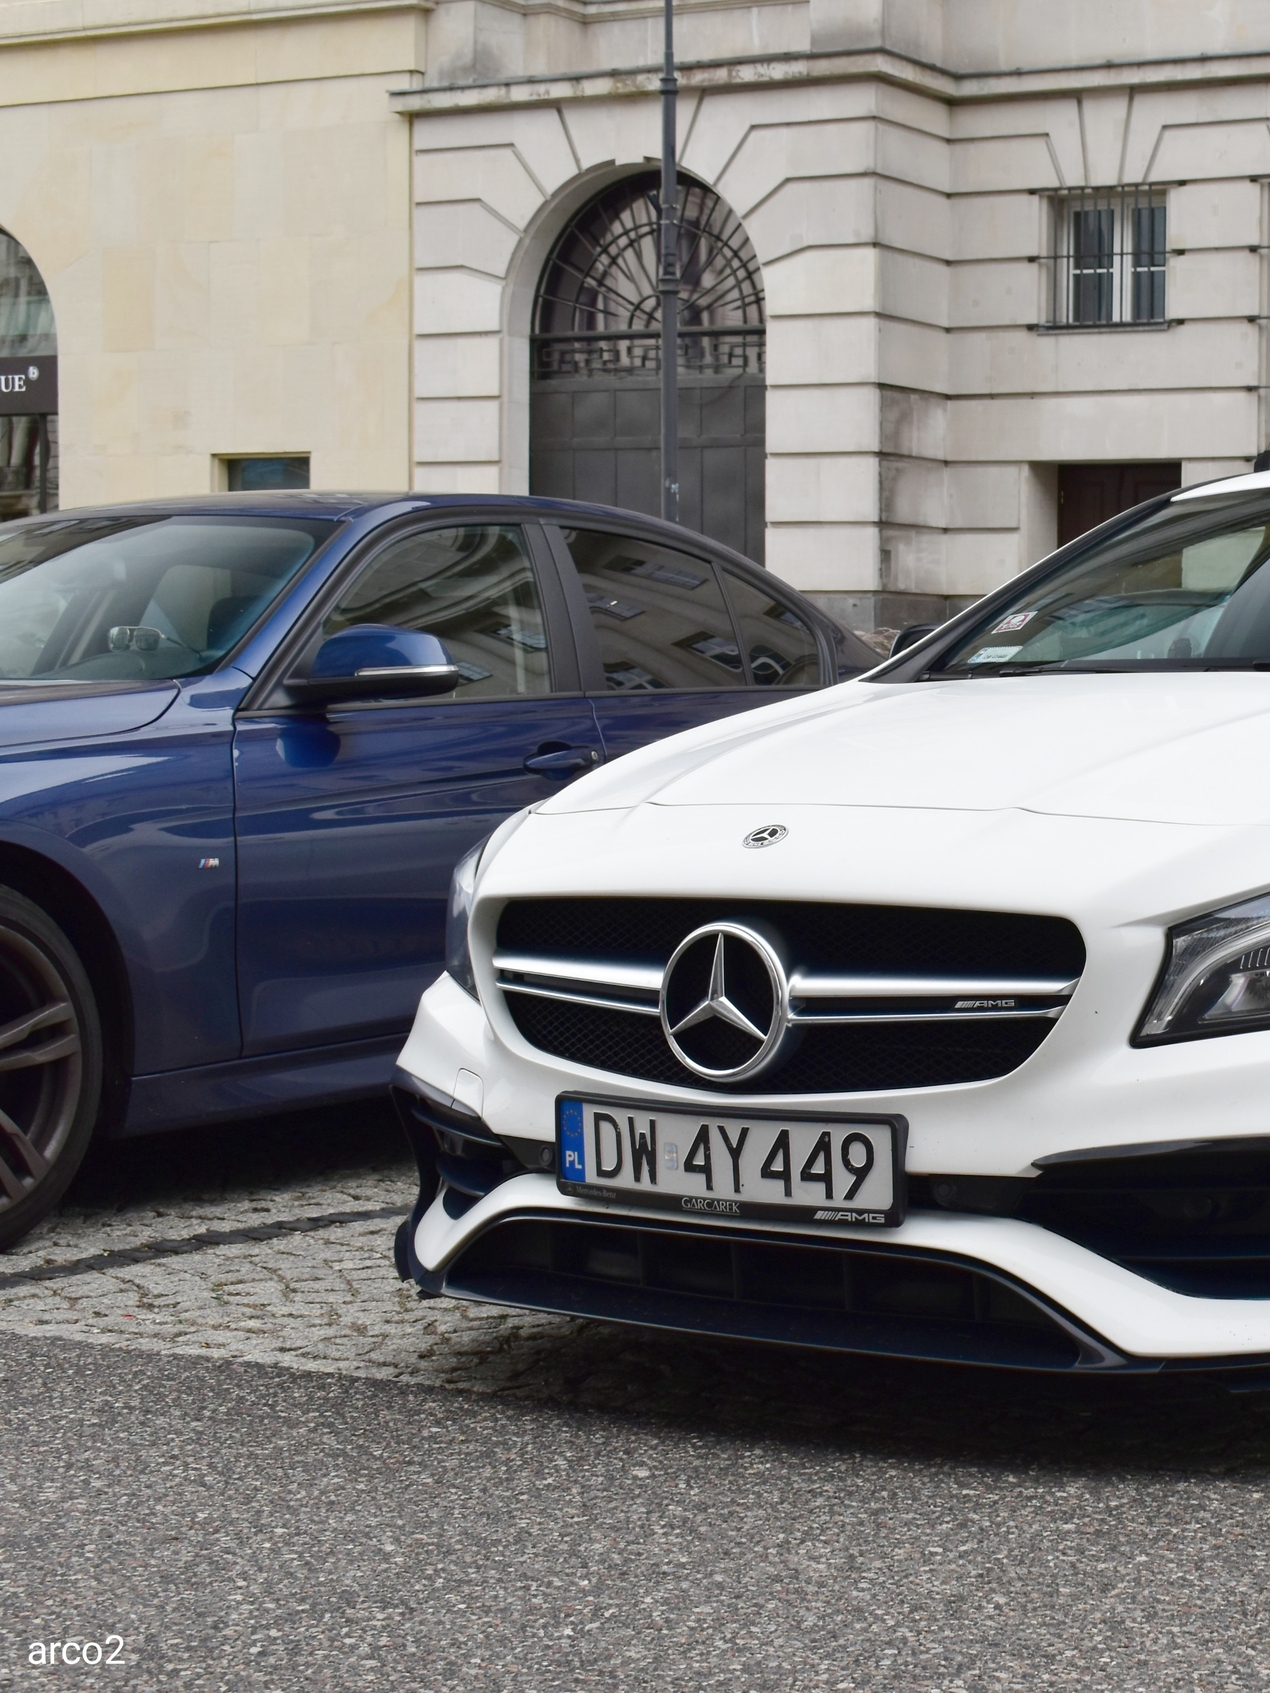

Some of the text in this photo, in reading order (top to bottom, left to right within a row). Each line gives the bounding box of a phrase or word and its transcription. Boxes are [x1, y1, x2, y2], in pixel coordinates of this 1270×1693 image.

[972, 999, 1015, 1009] AMG
[565, 1150, 583, 1170] PL
[593, 1110, 875, 1201] DW 4Y449
[575, 1185, 618, 1199] Mercedes-Benz
[681, 1197, 741, 1214] GARCAREK
[834, 1211, 885, 1223] AMG
